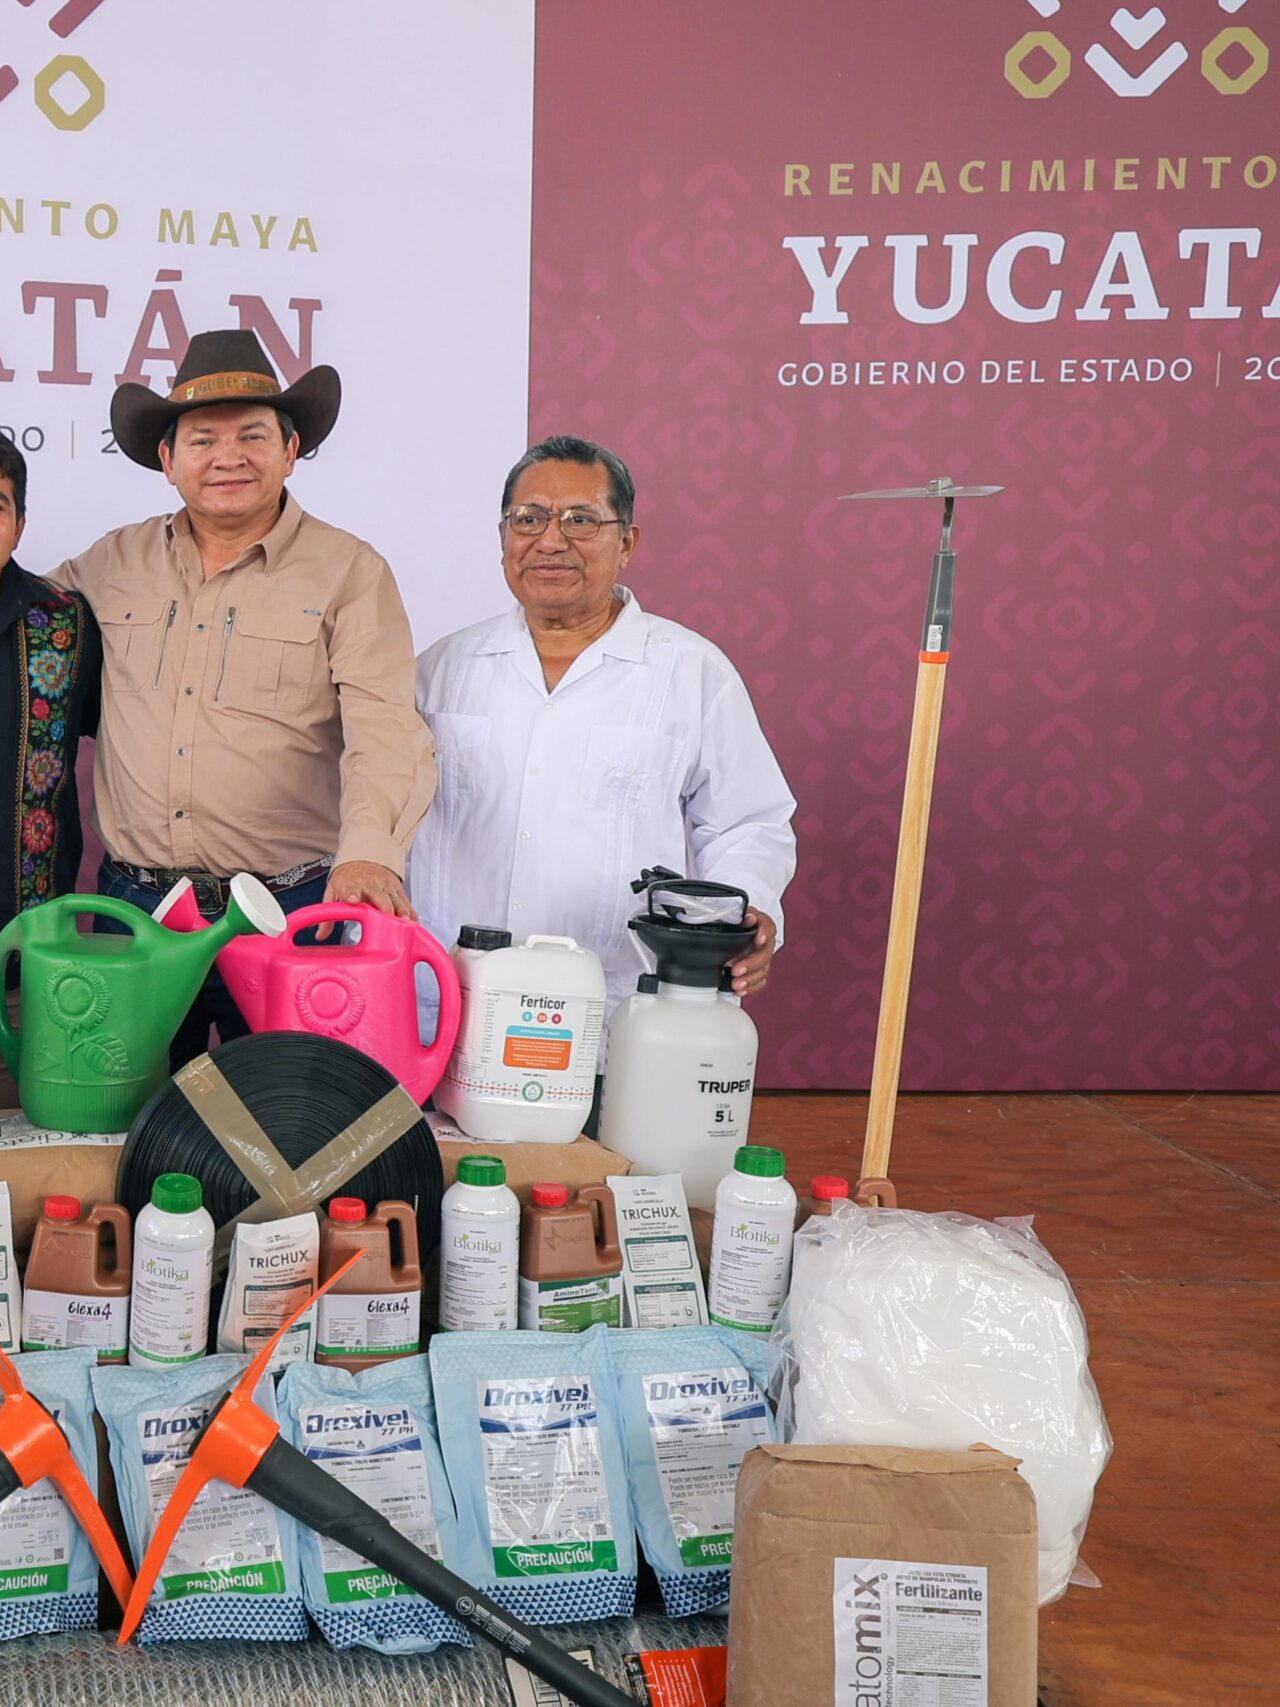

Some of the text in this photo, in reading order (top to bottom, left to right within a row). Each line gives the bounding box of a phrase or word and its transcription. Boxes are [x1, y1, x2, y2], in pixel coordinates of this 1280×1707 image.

[783, 155, 1277, 197] RENACIMIENTO
[157, 207, 320, 253] MAYA
[782, 228, 1280, 325] YUCAT
[778, 360, 966, 387] GOBIERNO
[980, 360, 1045, 384] DEL
[1059, 357, 1193, 383] ESTADO
[521, 995, 566, 1010] Ferticor
[698, 1079, 751, 1094] TRUPER
[715, 1110, 734, 1122] 5 L
[621, 1206, 681, 1220] TRICHUX
[453, 1234, 502, 1252] Biotika
[730, 1224, 780, 1244] Biotika
[249, 1249, 311, 1268] TRICHUX
[141, 1259, 190, 1280] Biotika
[484, 1384, 589, 1407] Droxivel
[649, 1377, 755, 1401] Droxivel
[306, 1410, 409, 1434] Droxivel
[381, 1428, 395, 1436] 77
[517, 1548, 594, 1567] PRECAUCIÓN
[347, 1573, 405, 1593] PRECAU
[895, 1582, 983, 1602] Fertilizante
